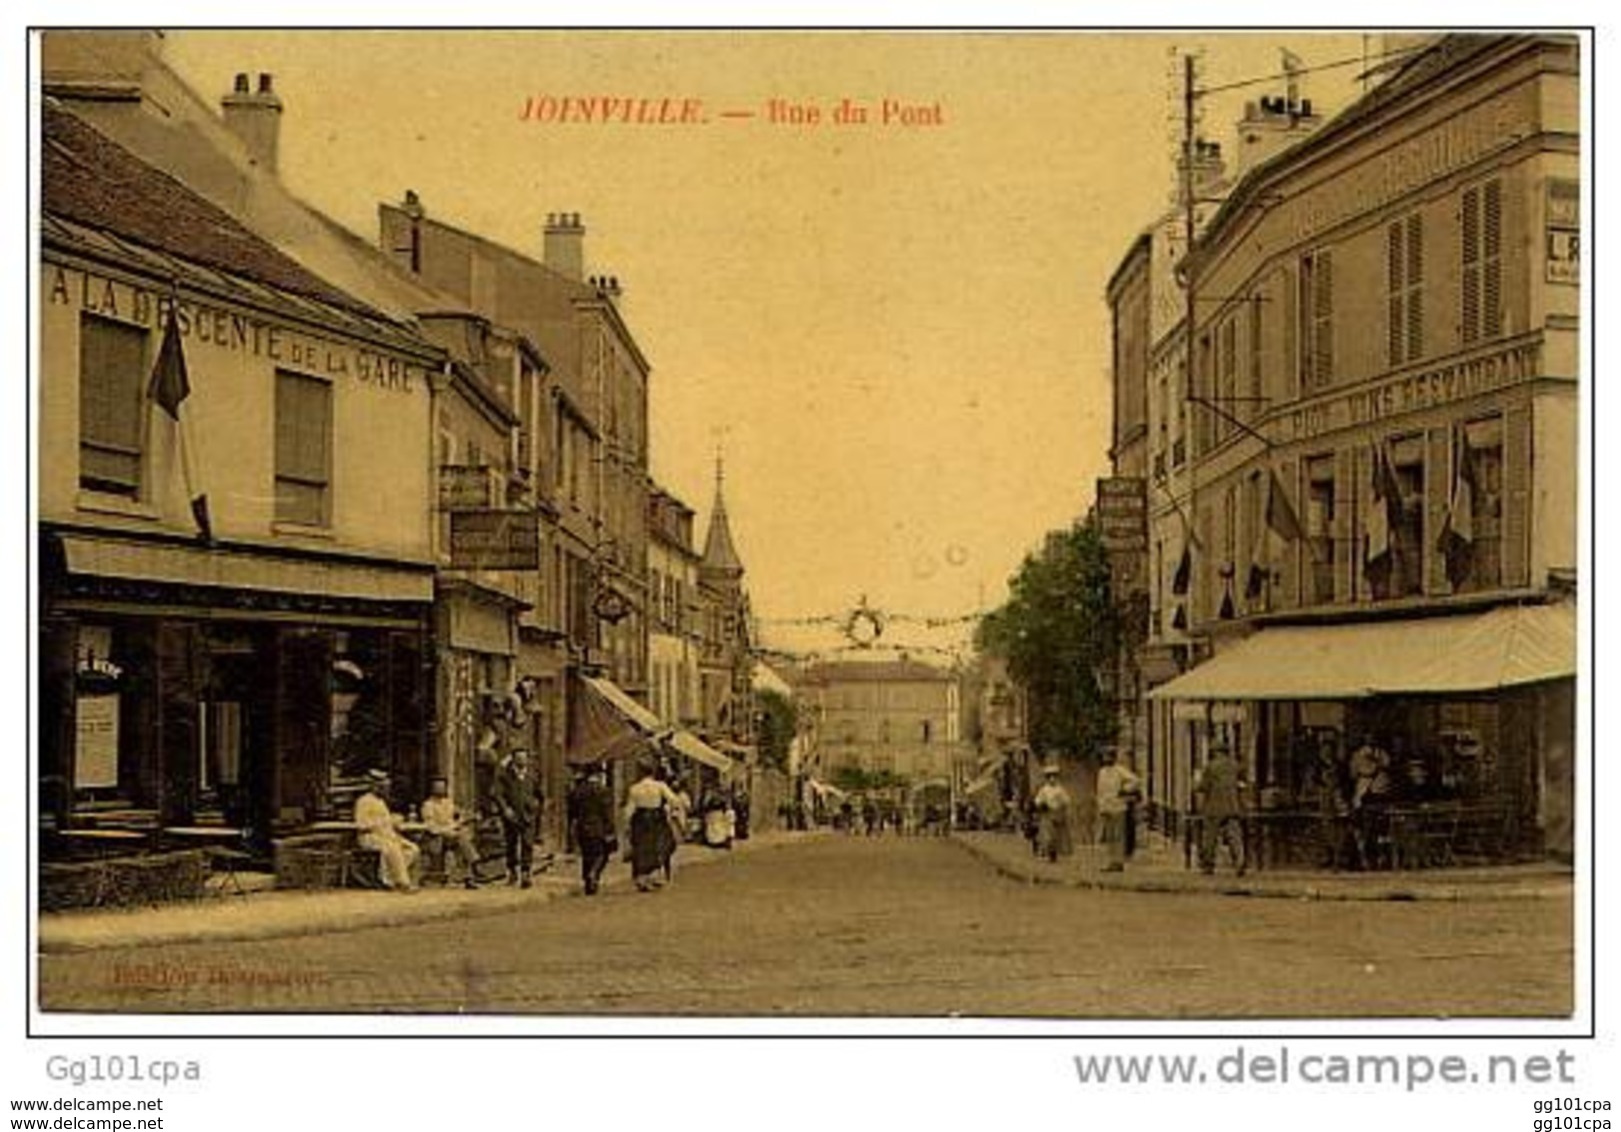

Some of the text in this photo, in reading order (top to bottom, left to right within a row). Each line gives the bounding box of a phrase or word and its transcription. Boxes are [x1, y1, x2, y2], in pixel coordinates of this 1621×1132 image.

[50, 269, 70, 304] A
[82, 271, 118, 317] LA
[291, 343, 317, 367] DE
[326, 351, 348, 373] LA
[355, 348, 414, 395] GARE
